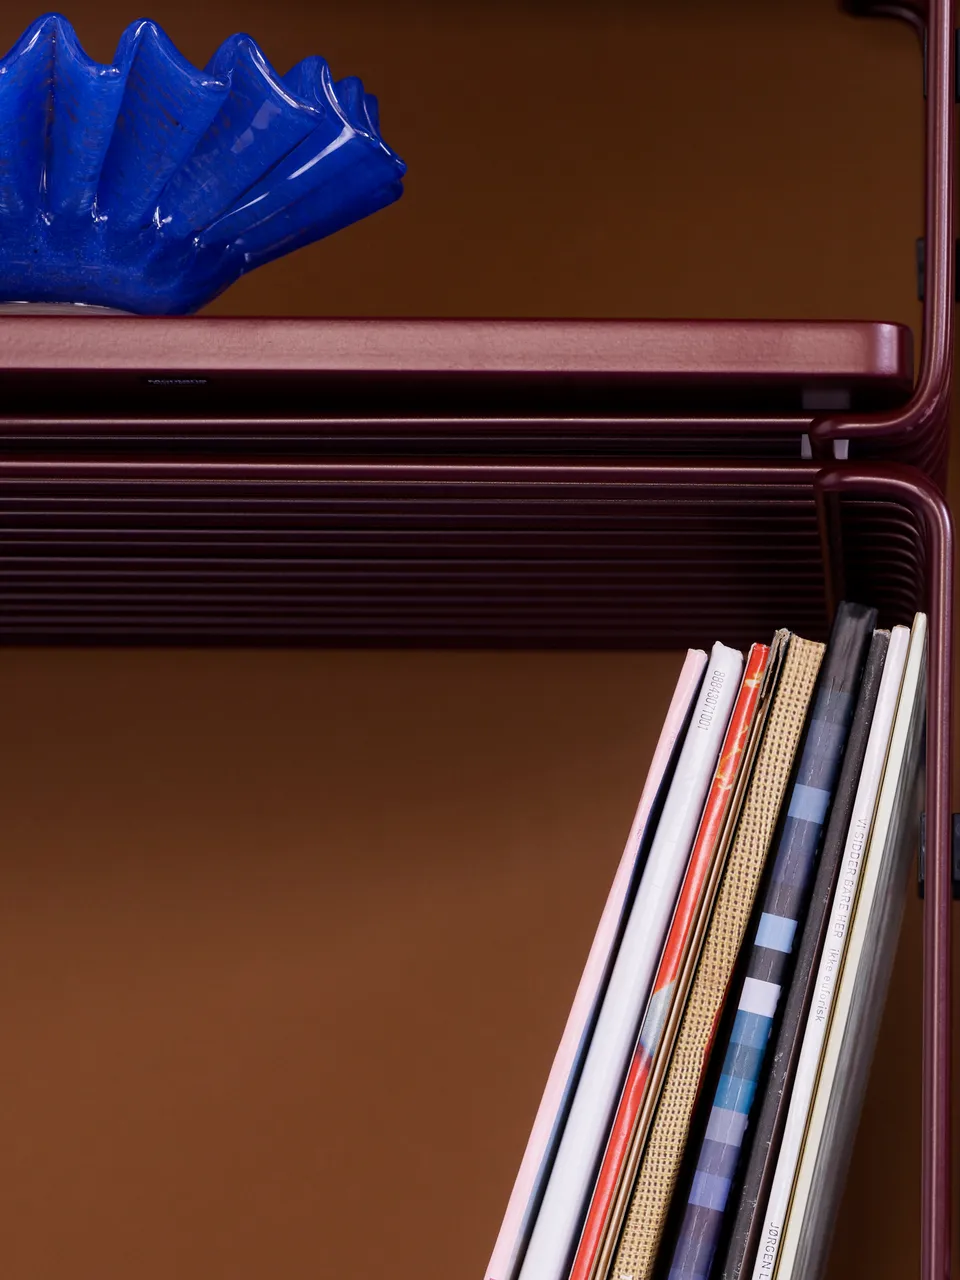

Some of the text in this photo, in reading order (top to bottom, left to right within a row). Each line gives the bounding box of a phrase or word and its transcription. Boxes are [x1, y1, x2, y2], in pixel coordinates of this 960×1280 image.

[697, 670, 726, 731] 88843071001
[847, 832, 865, 876] SIDDER
[838, 879, 854, 911] BARE
[833, 915, 847, 939] HER
[815, 948, 839, 1022] ikke euforisk
[762, 1221, 780, 1272] JØRGEN
